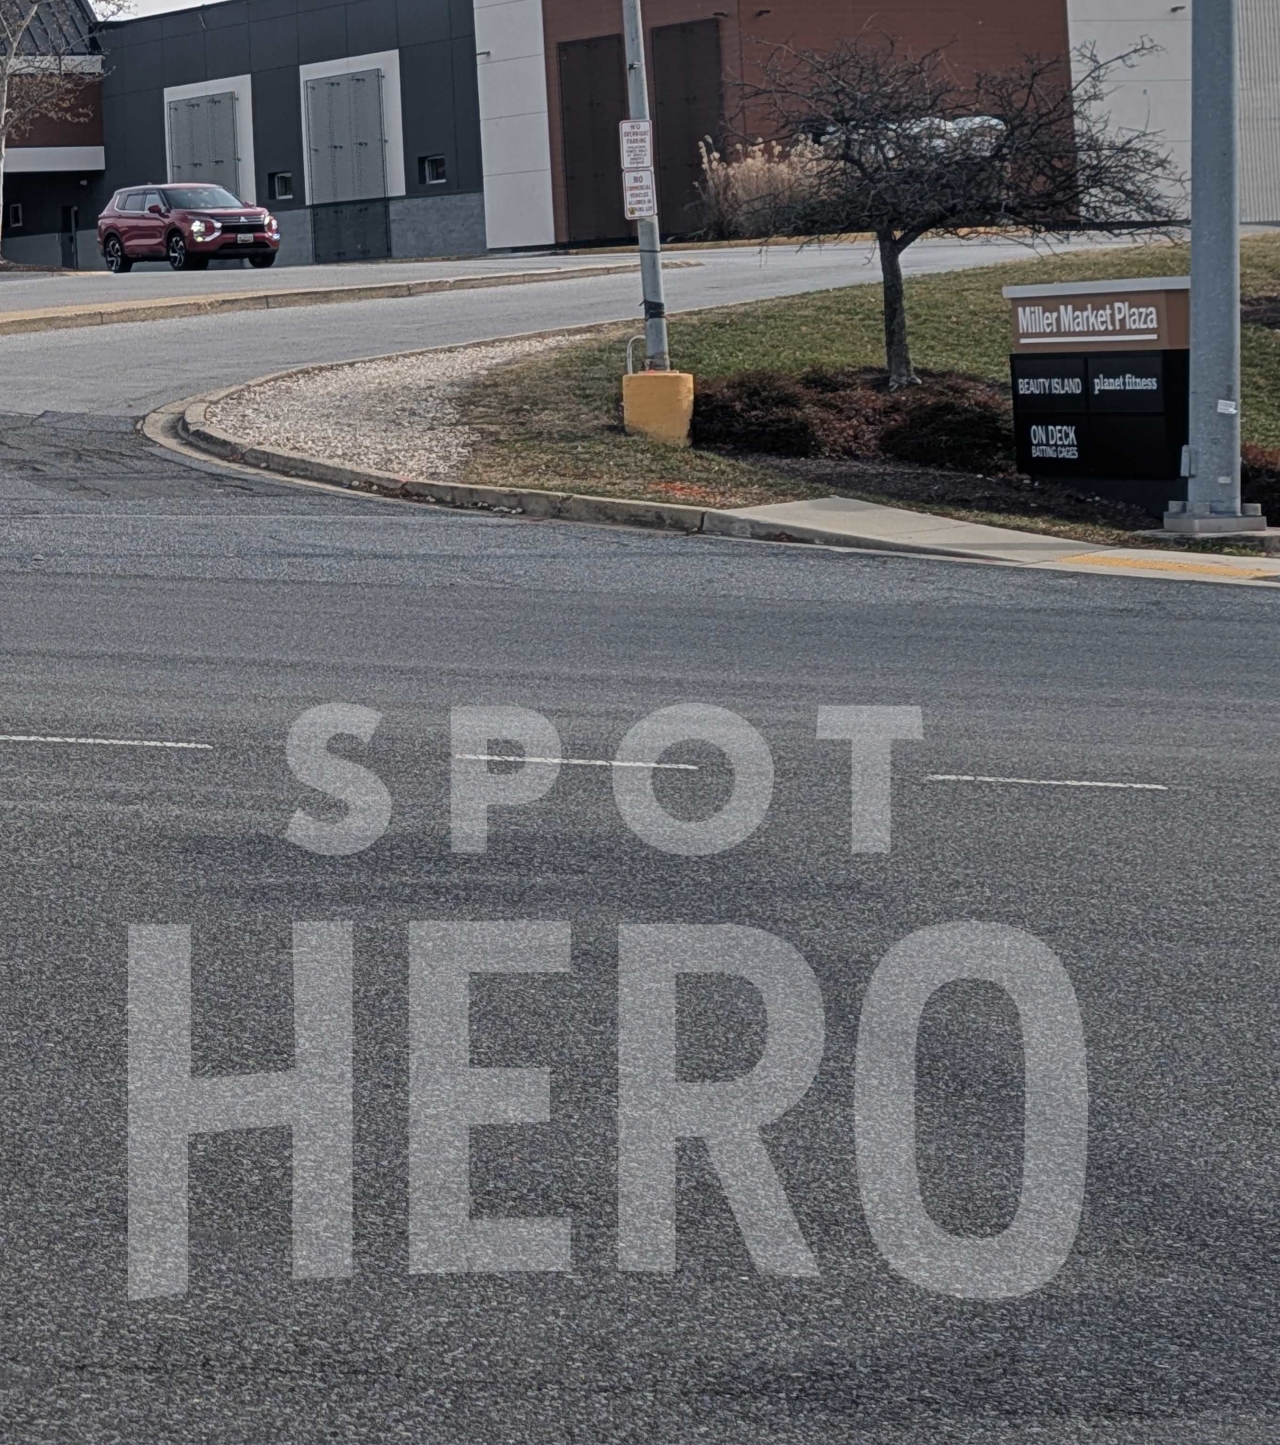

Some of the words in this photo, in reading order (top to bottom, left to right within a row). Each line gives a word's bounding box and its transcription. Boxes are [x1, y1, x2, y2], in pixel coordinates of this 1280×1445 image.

[633, 175, 643, 183] NO
[1018, 306, 1058, 333] Miller
[1060, 303, 1113, 332] Market
[1114, 301, 1158, 330] Plaza
[1018, 378, 1050, 394] BEAUTY
[1051, 378, 1082, 394] ISLAND
[1093, 374, 1124, 394] planet
[1125, 374, 1158, 390] fitness
[1031, 425, 1046, 444] ON
[1048, 425, 1077, 445] DECK
